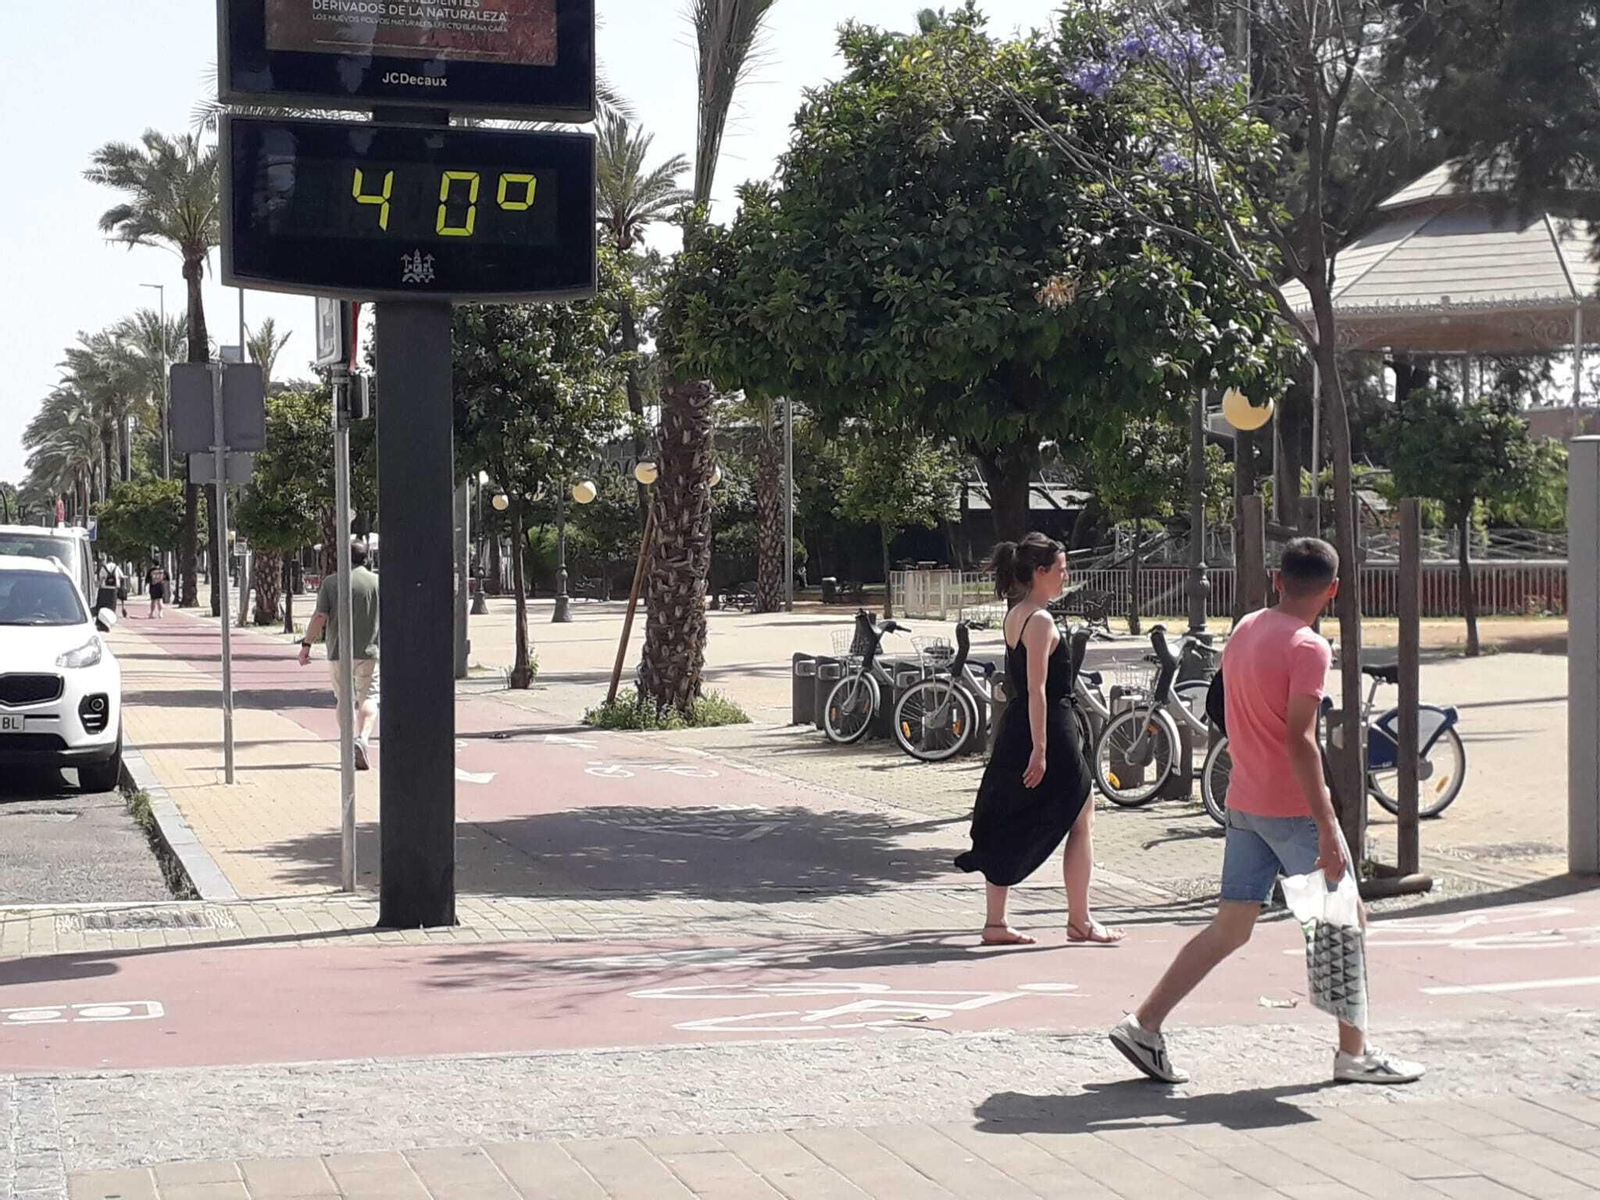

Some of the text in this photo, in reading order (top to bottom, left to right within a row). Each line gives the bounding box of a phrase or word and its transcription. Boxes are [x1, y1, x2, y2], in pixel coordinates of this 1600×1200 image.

[312, 0, 386, 14] DERIVADOS
[389, 4, 406, 15] DE
[409, 6, 424, 16] LA
[382, 72, 448, 87] JCDecaux
